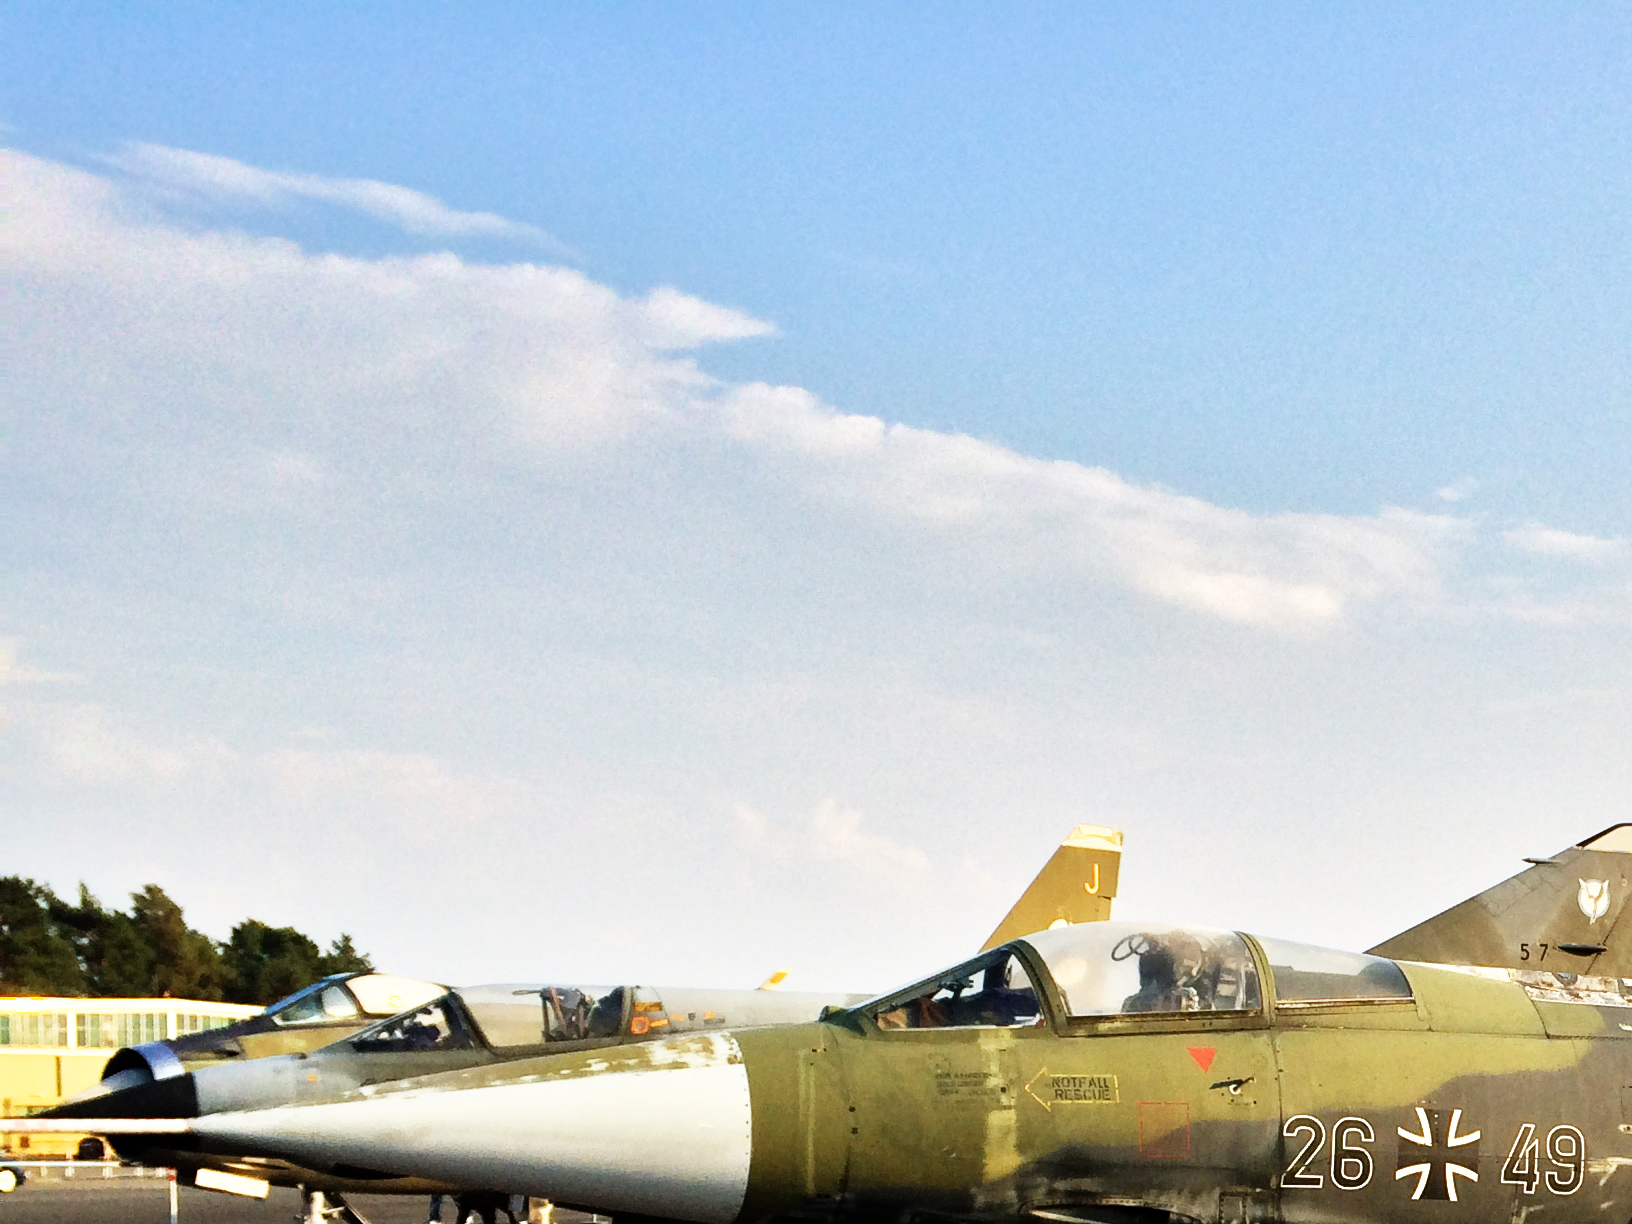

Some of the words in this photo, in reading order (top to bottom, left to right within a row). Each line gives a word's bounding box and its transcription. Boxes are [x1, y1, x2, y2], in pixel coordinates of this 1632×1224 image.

[1084, 863, 1099, 895] J
[1051, 1077, 1110, 1089] NOTFALL
[1054, 1089, 1112, 1101] RESCUE
[1281, 1114, 1375, 1190] 26
[1501, 1123, 1585, 1195] 49
